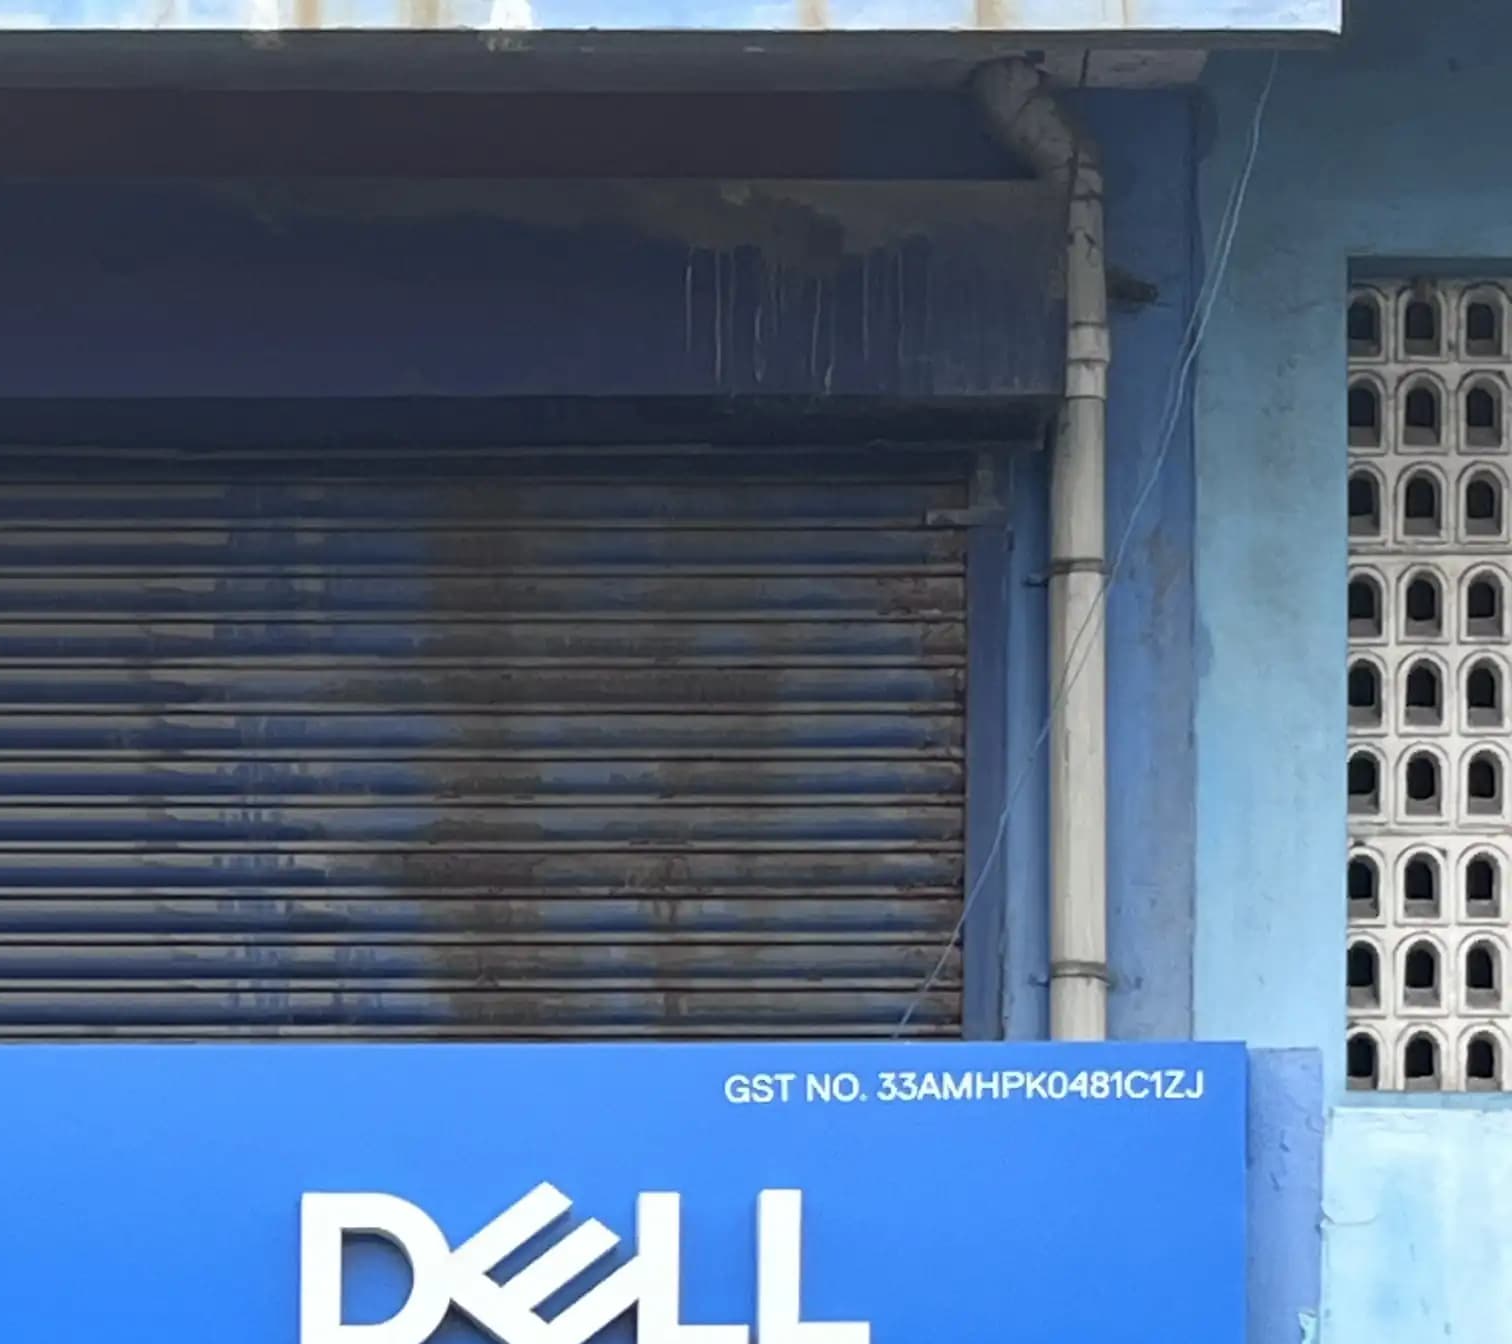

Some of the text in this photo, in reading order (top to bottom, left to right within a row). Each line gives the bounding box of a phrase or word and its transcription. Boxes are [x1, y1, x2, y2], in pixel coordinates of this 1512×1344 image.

[724, 1069, 1204, 1103] GST NO. 33AMHPK0481C1ZJ
